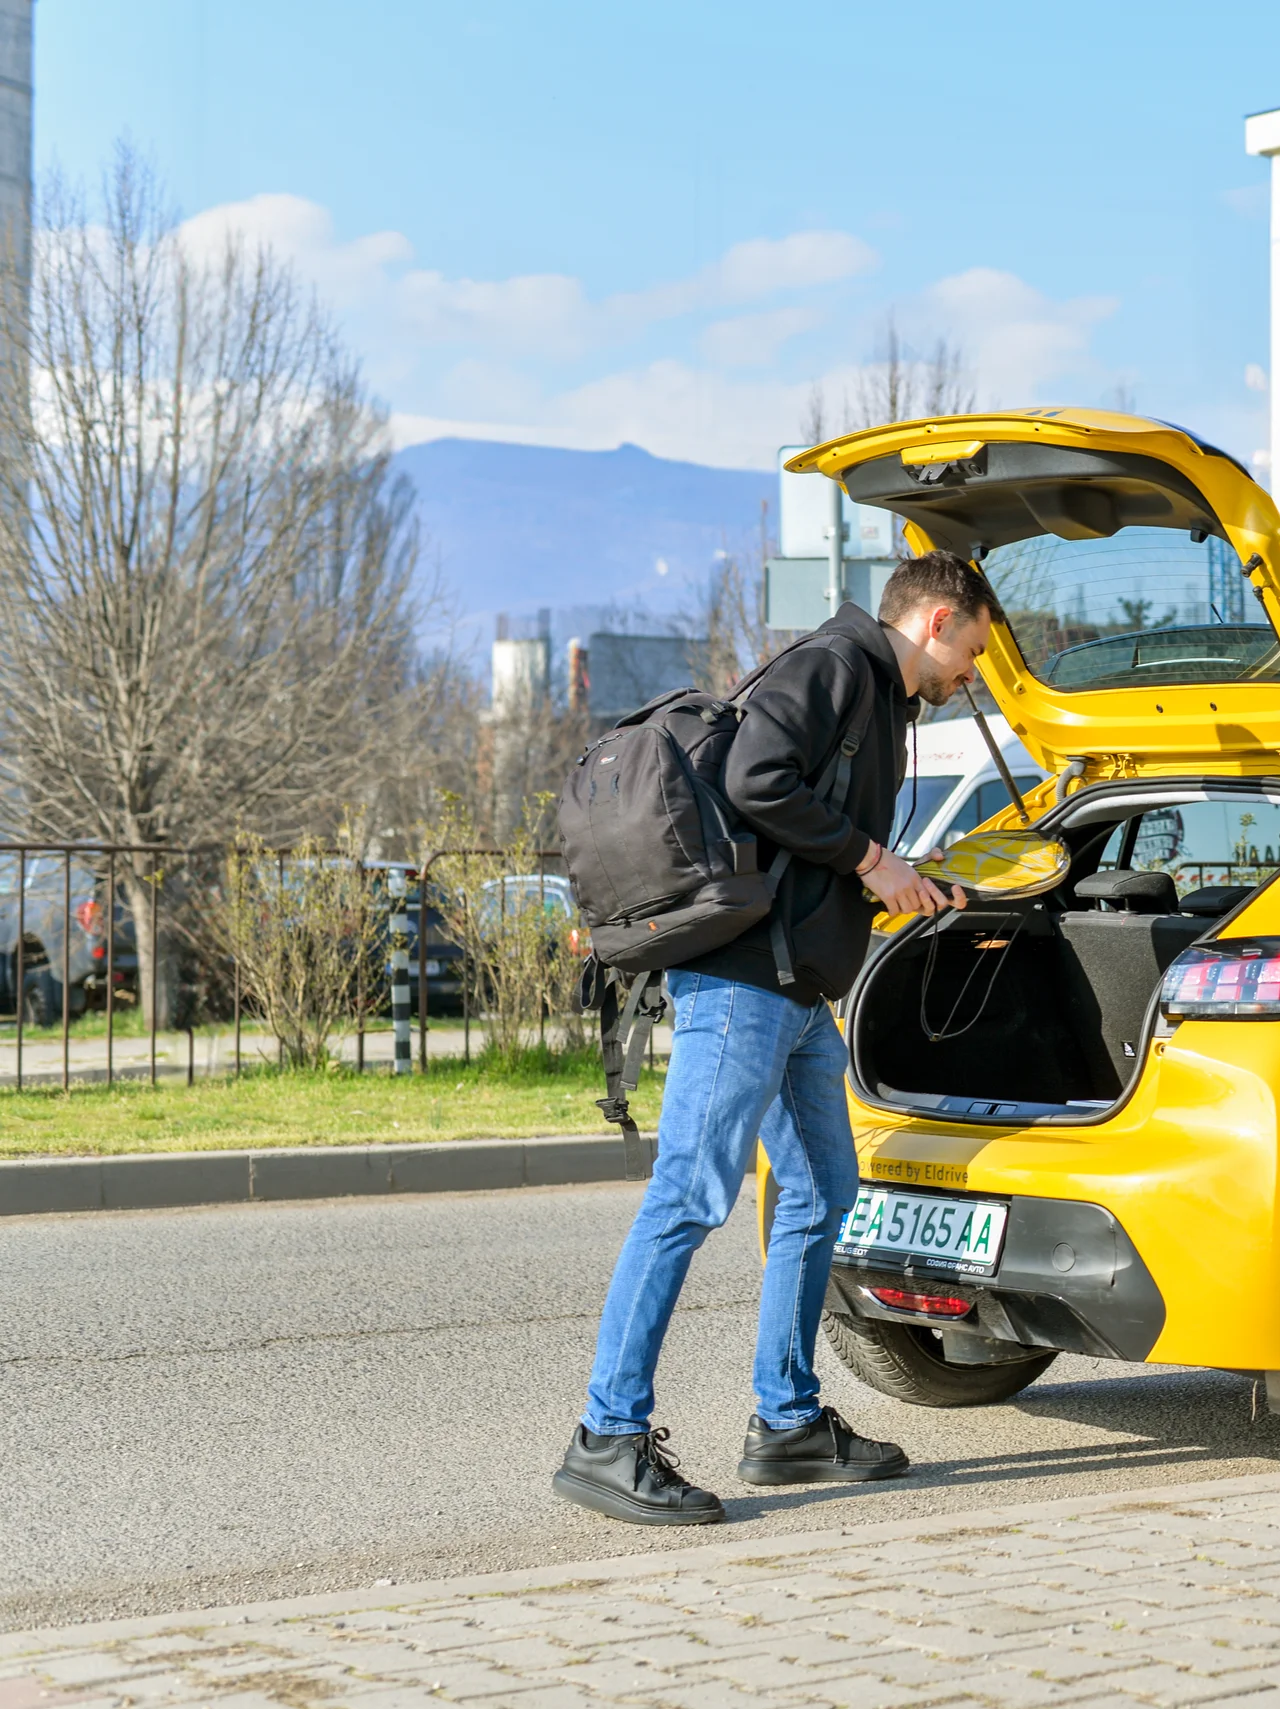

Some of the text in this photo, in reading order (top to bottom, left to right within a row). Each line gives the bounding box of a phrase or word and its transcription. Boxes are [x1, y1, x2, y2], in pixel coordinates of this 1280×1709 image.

[859, 1160, 969, 1184] owered by Eldrive
